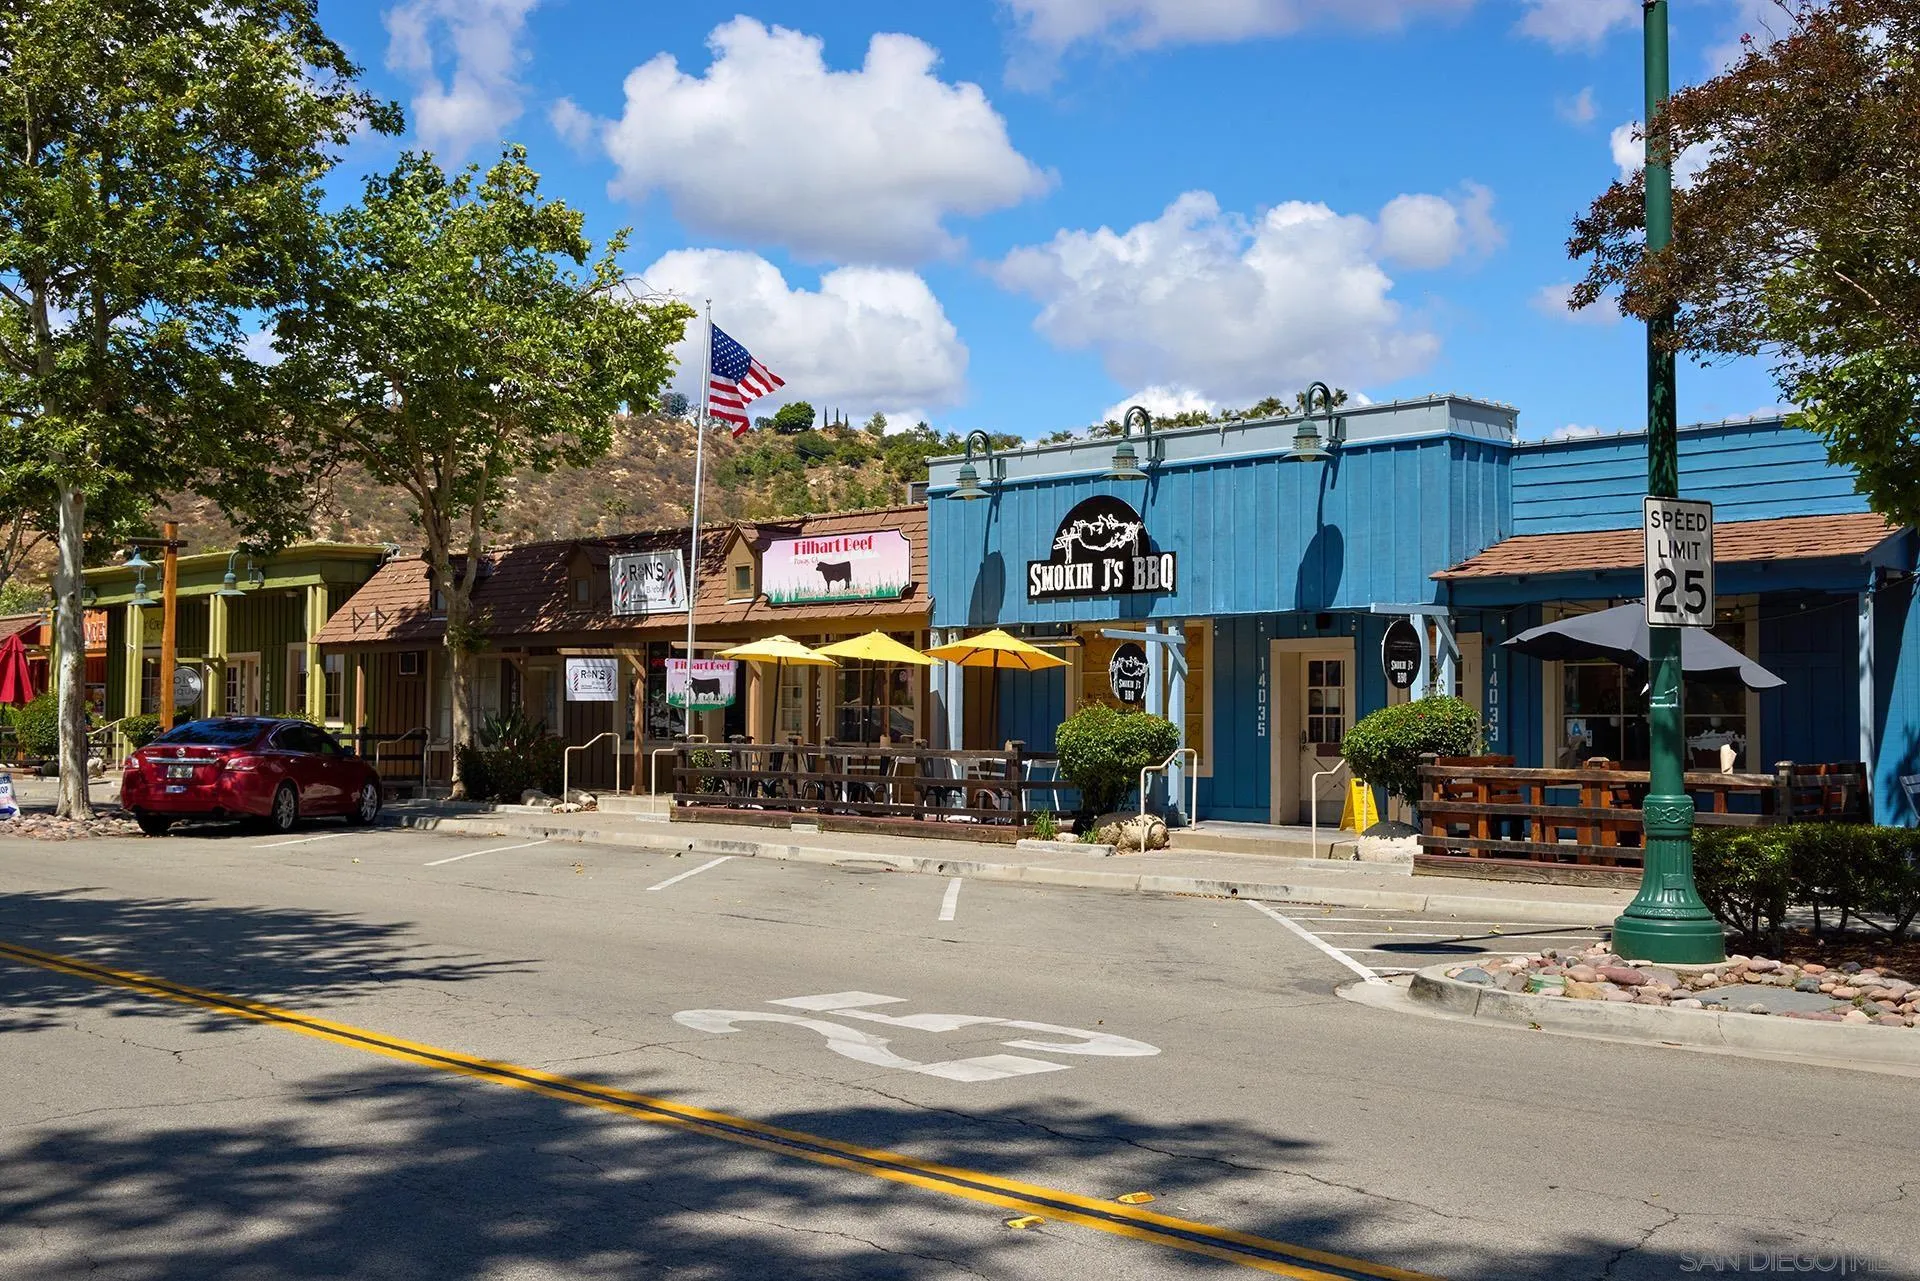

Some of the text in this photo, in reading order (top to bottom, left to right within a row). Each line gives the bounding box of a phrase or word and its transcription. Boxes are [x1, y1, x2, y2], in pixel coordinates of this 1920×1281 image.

[1651, 509, 1707, 532] SPEED
[794, 535, 874, 556] Filhart Beef
[1658, 539, 1701, 560] LIMIT
[1132, 553, 1174, 591] BBQ
[1654, 568, 1707, 614] 25
[1257, 656, 1266, 737] 14035
